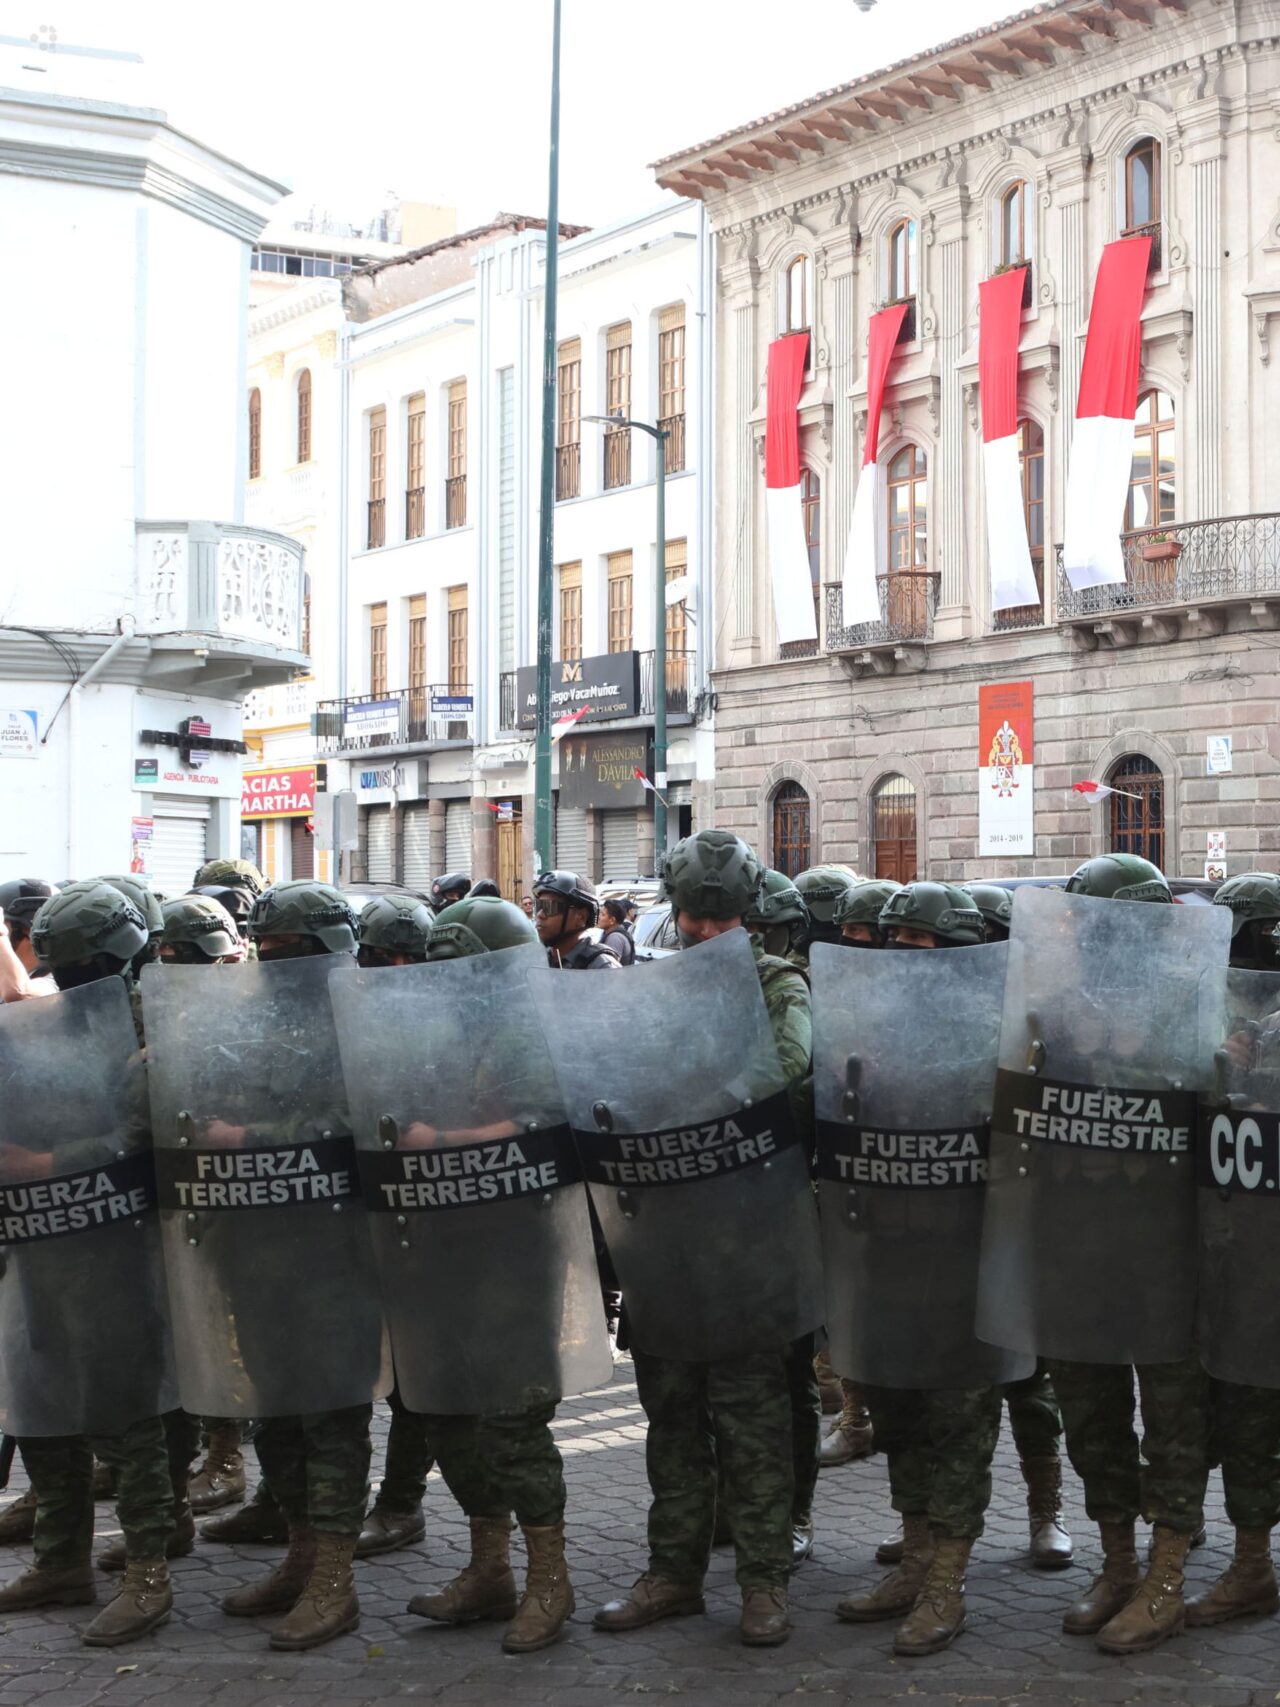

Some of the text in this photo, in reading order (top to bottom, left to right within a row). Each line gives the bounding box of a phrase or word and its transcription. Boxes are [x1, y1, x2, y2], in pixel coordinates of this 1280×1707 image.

[570, 687, 589, 700] Vaca
[590, 682, 620, 698] Muñoz
[592, 746, 645, 762] ALESSANDRO
[164, 772, 184, 781] AGENCIA
[188, 774, 218, 784] PUBLICITARIA
[241, 776, 291, 794] ACIAS
[241, 793, 312, 812] MARTHA
[1009, 834, 1023, 842] 2019
[1041, 1086, 1164, 1123] FUERZA
[619, 1119, 744, 1160] FUERZA
[1013, 1108, 1190, 1151] TERRESTRE
[402, 1142, 527, 1180] FUERZA
[601, 1129, 776, 1182] TERRESTRE
[860, 1133, 980, 1159] FUERZA
[197, 1149, 320, 1180] FUERZA
[835, 1154, 988, 1186] TERRESTR
[174, 1170, 351, 1207] TERRESTRE
[381, 1161, 558, 1208] TERRESTRE
